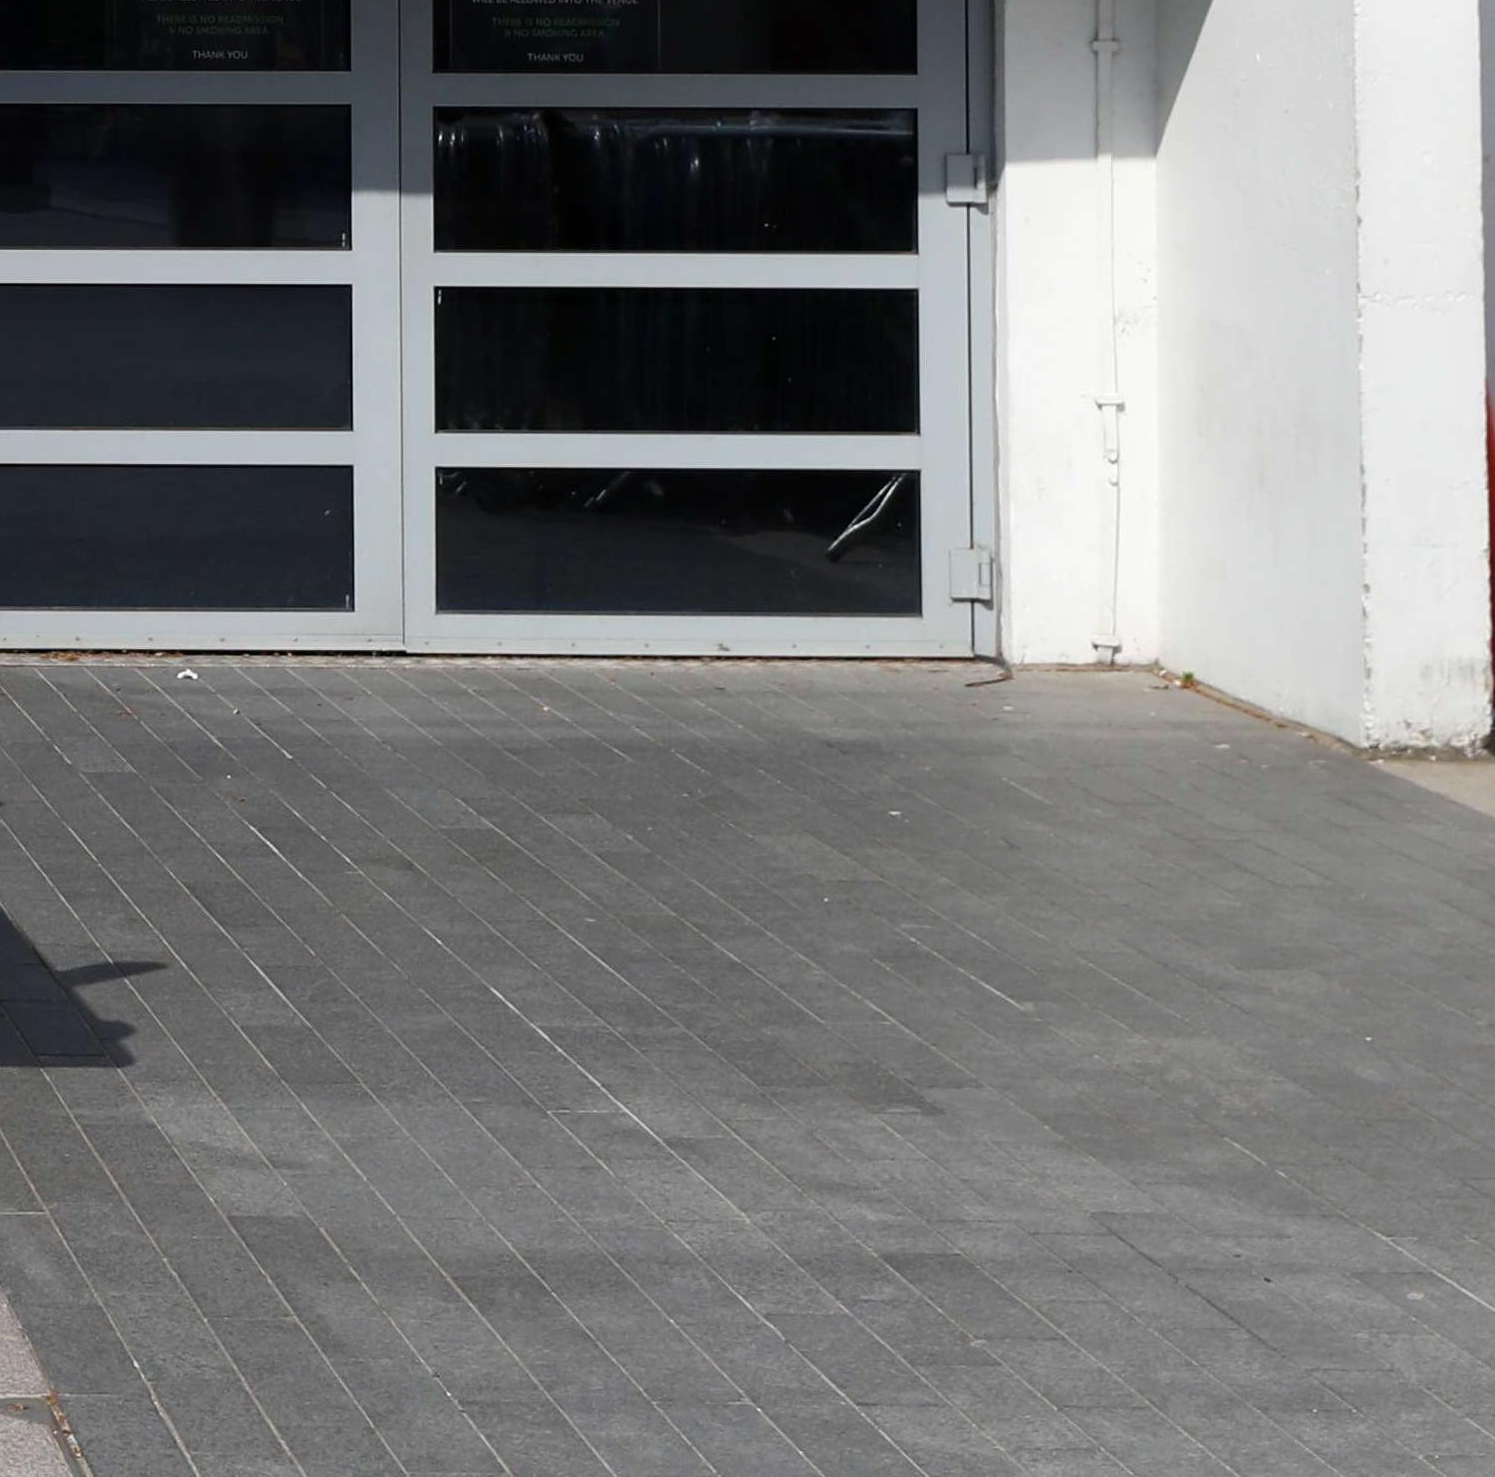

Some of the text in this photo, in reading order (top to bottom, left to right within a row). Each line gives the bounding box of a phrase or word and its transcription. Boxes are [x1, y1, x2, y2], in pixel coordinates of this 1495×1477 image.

[192, 50, 249, 60] THANK YOU
[526, 53, 585, 63] THANK YOU
